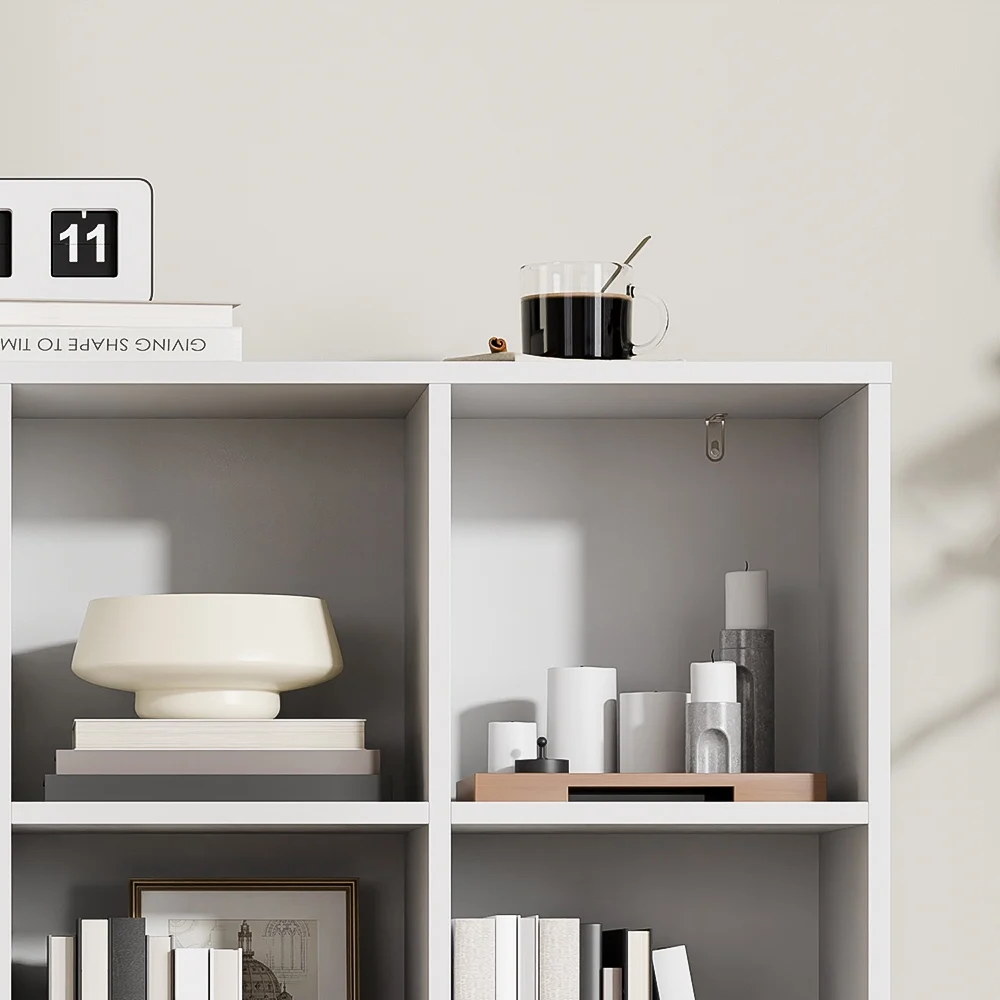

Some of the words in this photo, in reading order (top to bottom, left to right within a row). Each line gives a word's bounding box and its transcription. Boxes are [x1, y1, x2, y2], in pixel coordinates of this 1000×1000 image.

[58, 223, 107, 263] 11
[37, 337, 61, 352] TO
[68, 337, 129, 352] SHAPE
[135, 337, 207, 352] GIVING
